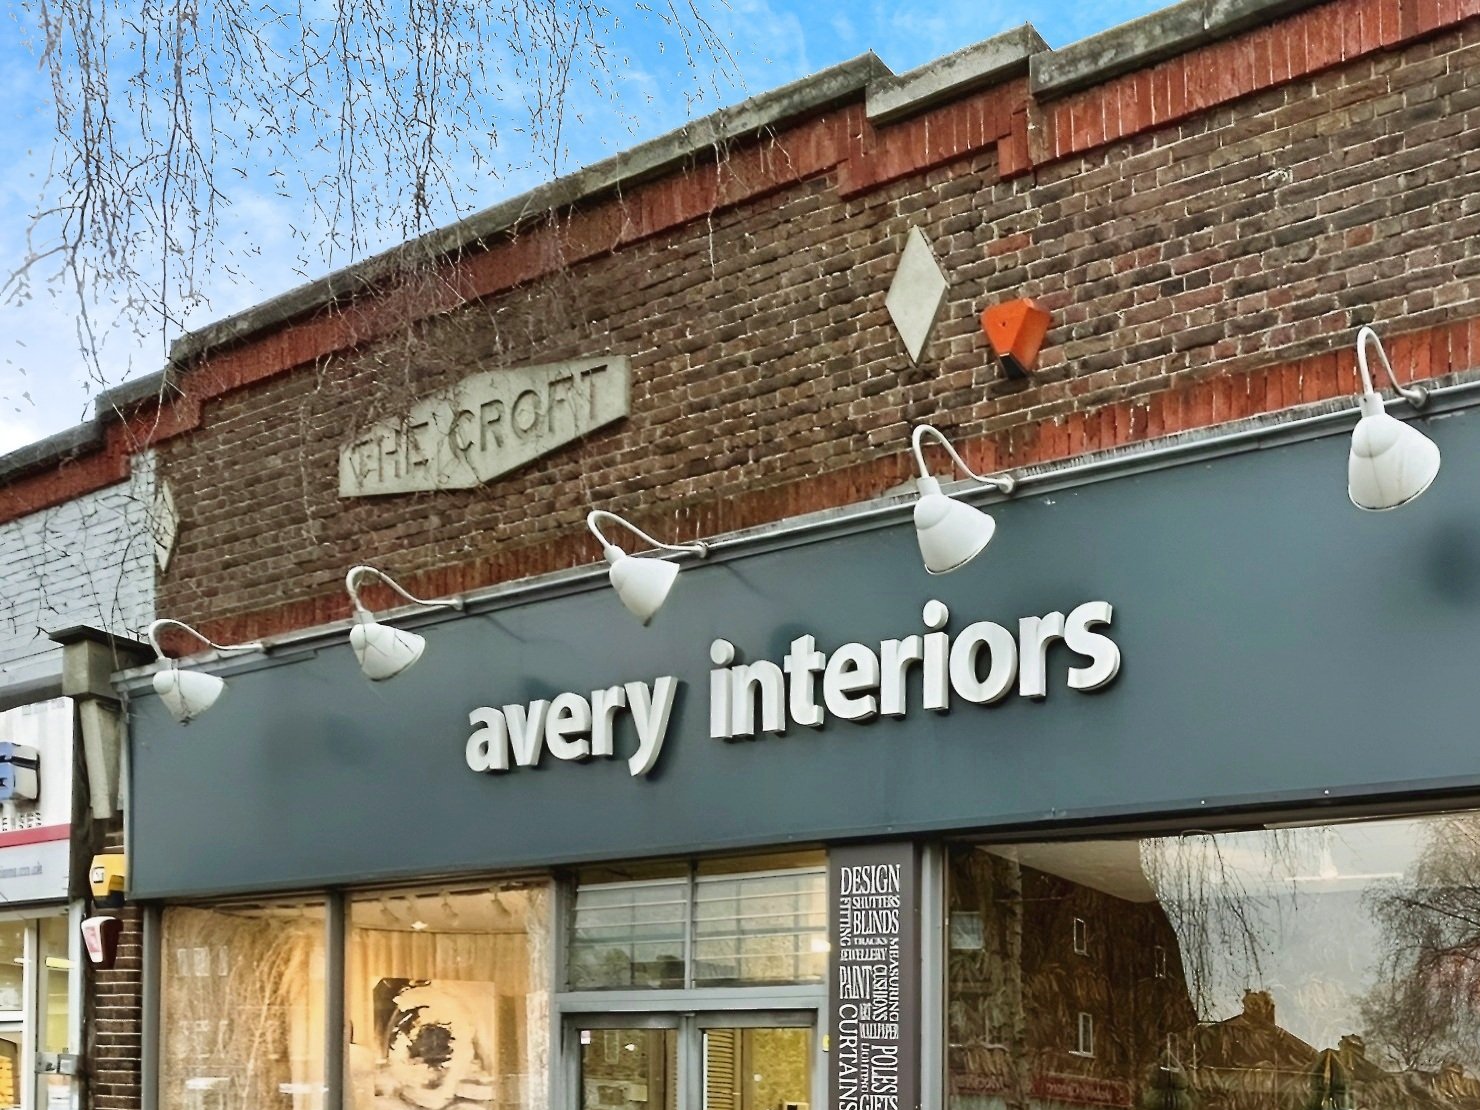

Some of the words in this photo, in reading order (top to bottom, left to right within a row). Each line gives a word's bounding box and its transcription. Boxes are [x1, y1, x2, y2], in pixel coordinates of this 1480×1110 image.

[449, 364, 607, 451] CROFT
[465, 676, 677, 777] avery
[709, 599, 1121, 739] interiors
[841, 864, 900, 895] DESIGN
[852, 895, 900, 909] SHUTTERS
[840, 897, 851, 947] FITTING
[853, 909, 899, 935] BLINDS
[840, 965, 872, 999] PAINT
[873, 965, 888, 1021] CUSHIONS
[889, 937, 899, 1021] MEASURING
[871, 1045, 898, 1093] POLES
